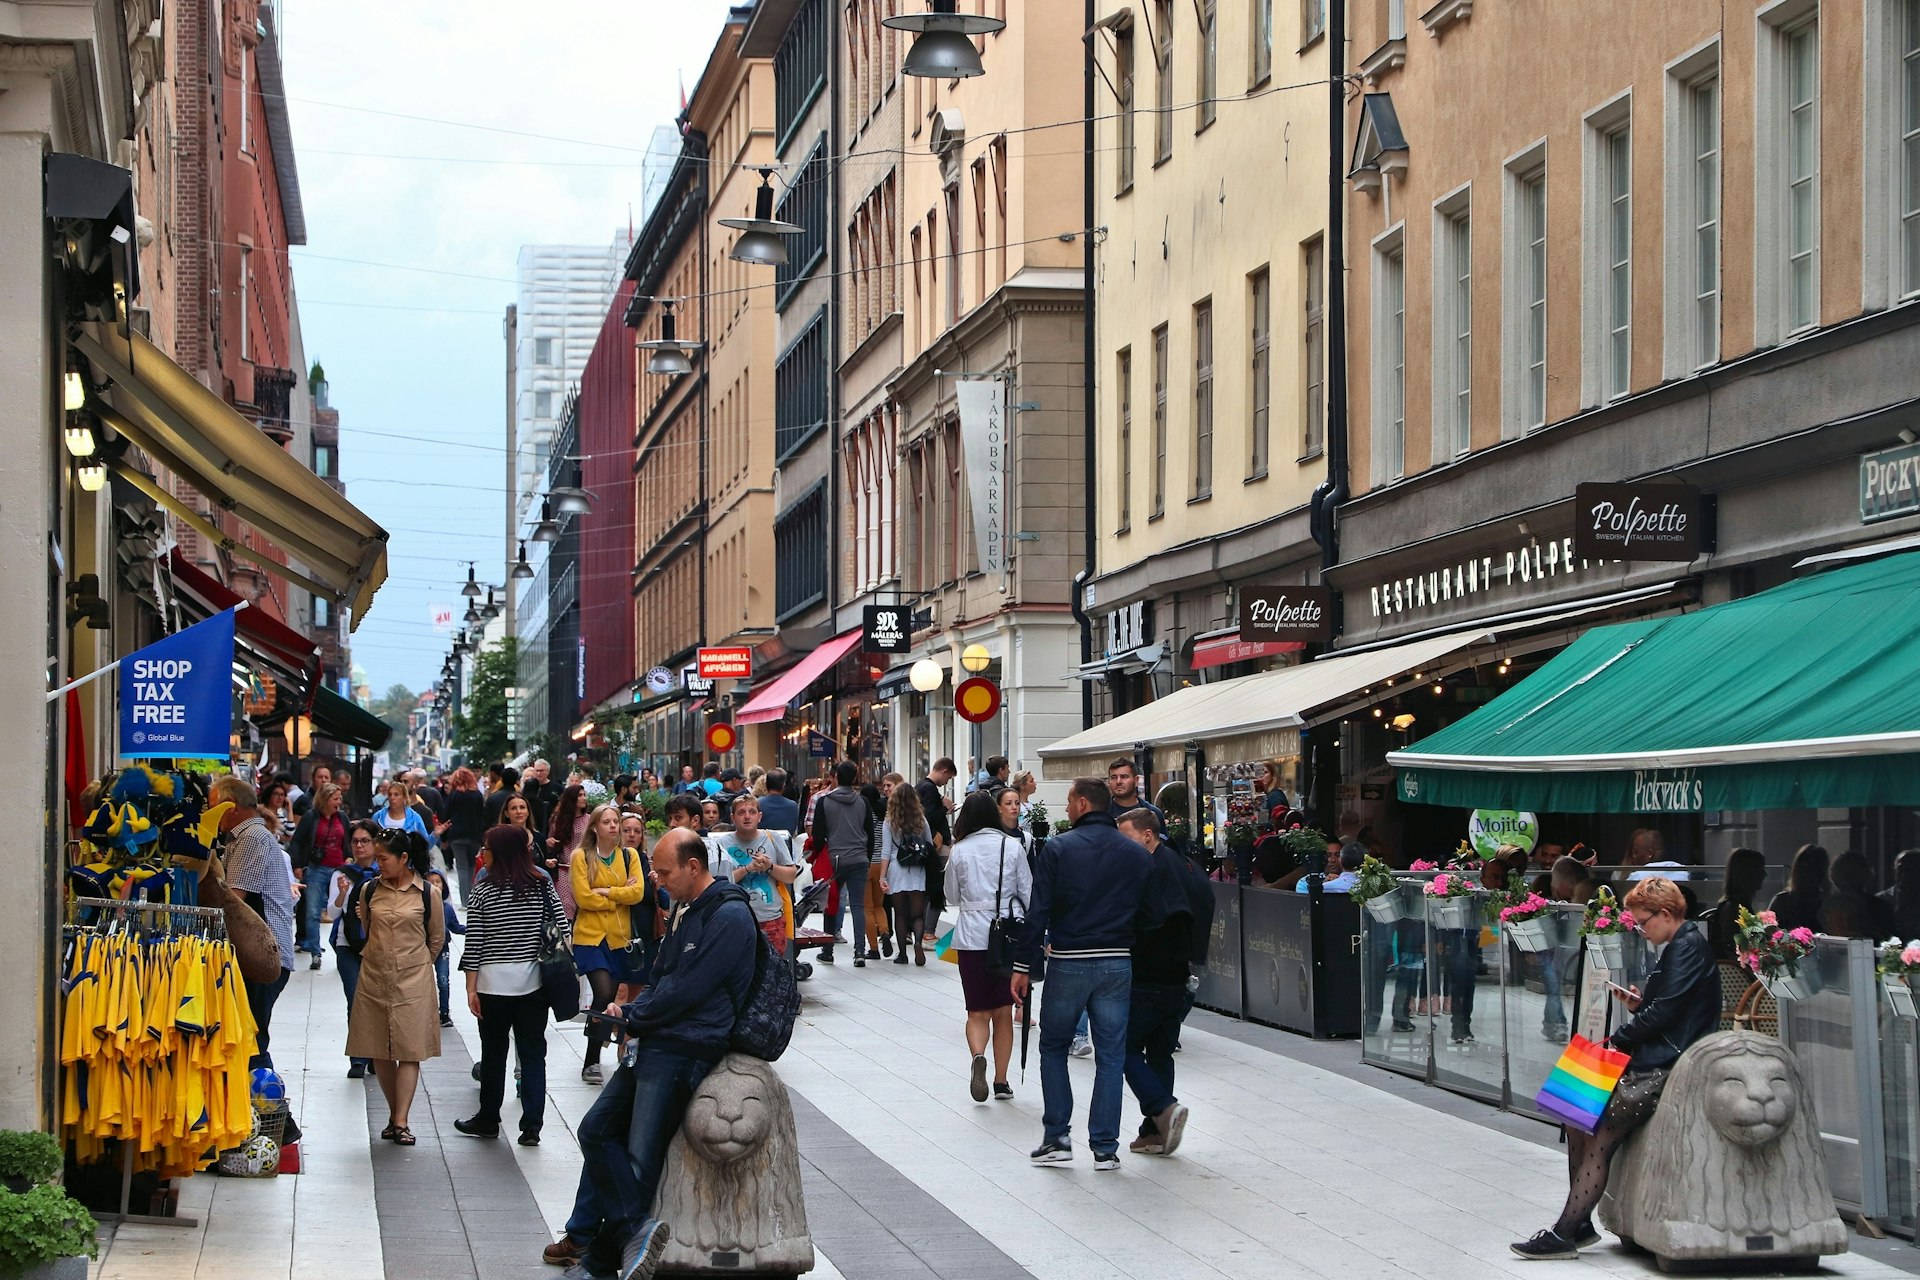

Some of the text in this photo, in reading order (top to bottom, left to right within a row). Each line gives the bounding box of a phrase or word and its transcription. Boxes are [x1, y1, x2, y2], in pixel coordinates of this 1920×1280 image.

[988, 389, 999, 571] JAKOBSARKADEN
[1591, 496, 1687, 546] Polpette
[1595, 533, 1625, 541] SWEDISH
[1630, 533, 1655, 541] ITALIAN
[1371, 557, 1492, 617] RESTAURANT
[1250, 595, 1321, 632] Polpette
[871, 631, 903, 639] MÅLERÅS
[701, 653, 749, 663] KARAMELL
[133, 660, 192, 679] SHOP
[133, 682, 175, 701] TAX
[133, 705, 185, 724] FREE
[148, 734, 184, 742] Global Blue
[1475, 816, 1528, 835] Mojito
